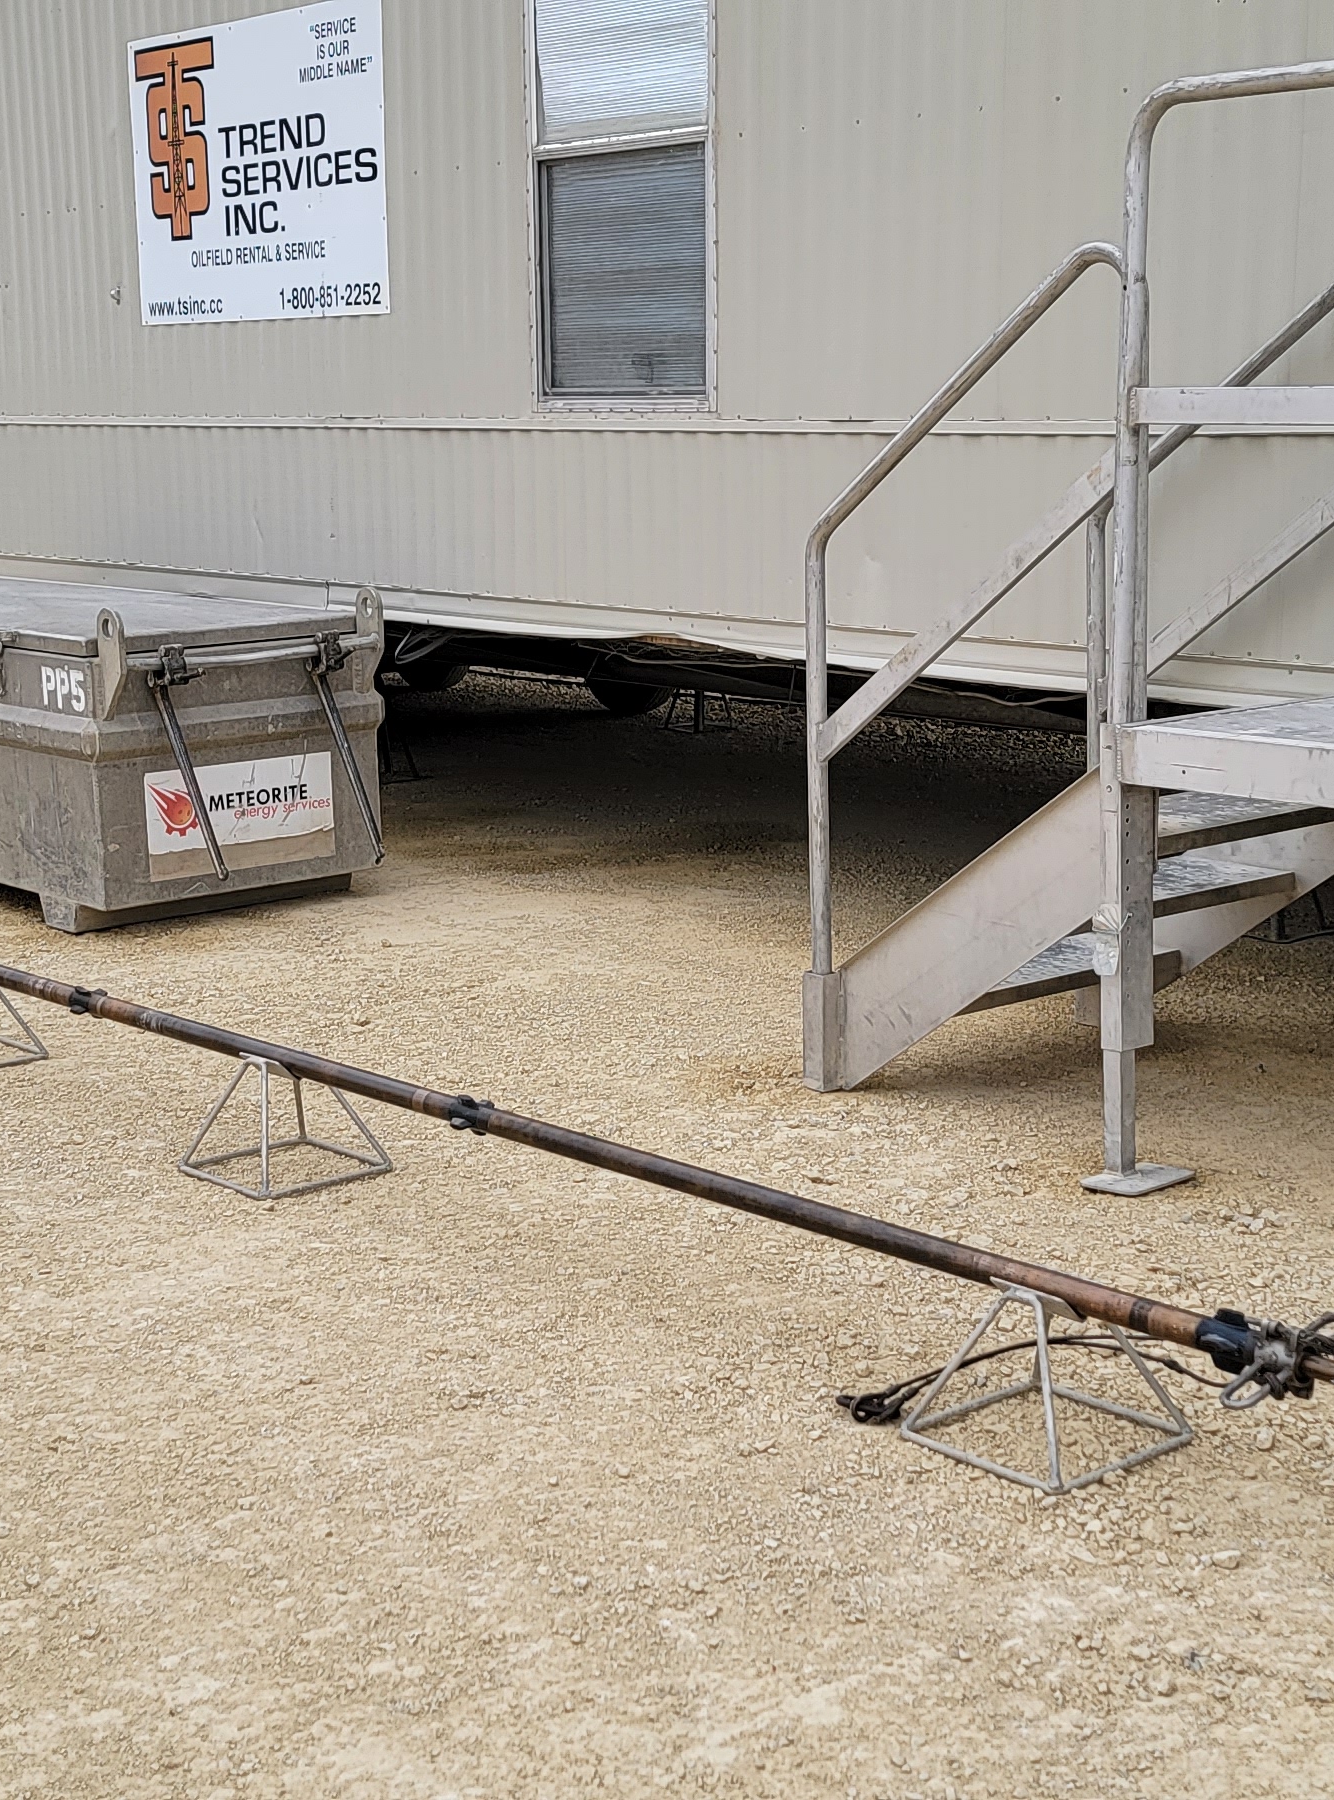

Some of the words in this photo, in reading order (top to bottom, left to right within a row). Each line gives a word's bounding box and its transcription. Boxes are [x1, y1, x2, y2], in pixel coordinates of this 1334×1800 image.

[316, 44, 326, 60] IS
[328, 40, 350, 58] OUR
[299, 61, 333, 83] MIDDLE
[218, 112, 326, 159] TREND
[221, 148, 378, 198] SERVICES
[224, 200, 286, 237] INC.
[191, 248, 233, 268] OILFIELD
[235, 244, 273, 265] RENTAL
[275, 244, 282, 261] &
[284, 240, 326, 261] SERVICE
[148, 296, 223, 317] www.tsinc.cc
[279, 282, 381, 311] 1-800-851-2252
[41, 666, 86, 712] PP5
[209, 783, 308, 812] METEORITE
[234, 803, 279, 820] energy
[283, 797, 331, 813] services
